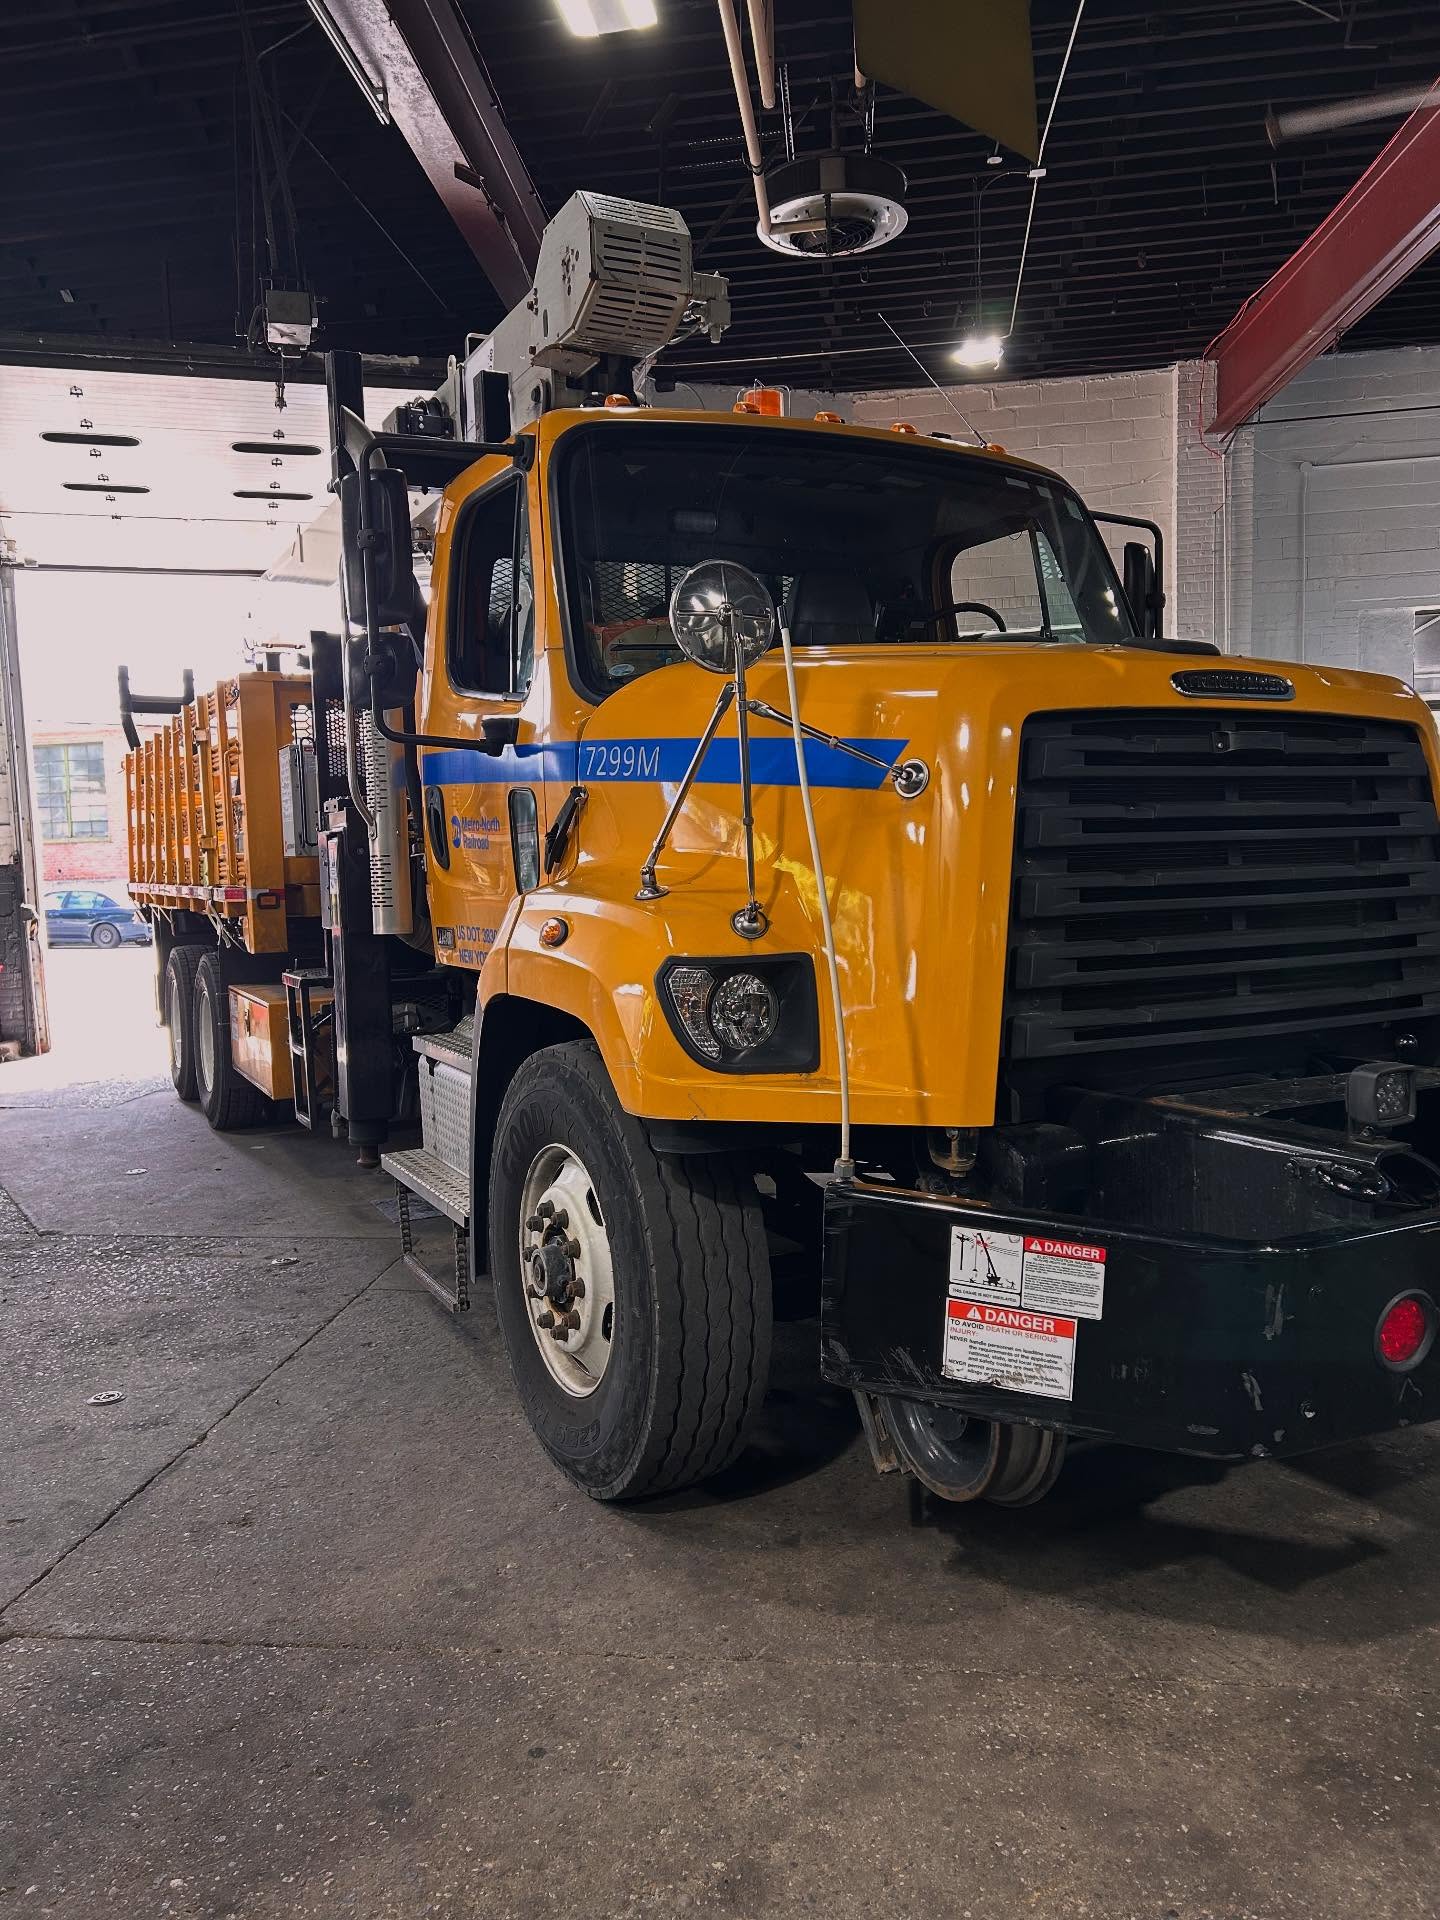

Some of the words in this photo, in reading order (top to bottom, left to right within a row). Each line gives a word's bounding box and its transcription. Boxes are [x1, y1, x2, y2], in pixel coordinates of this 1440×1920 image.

[586, 746, 660, 777] 7299M
[462, 816, 500, 832] Metro-North
[463, 834, 489, 850] Railroad
[456, 925, 466, 940] US
[467, 926, 480, 942] DOT
[459, 948, 473, 964] NEW
[1044, 1242, 1099, 1259] DANGER
[984, 1308, 1055, 1332] DANGER
[949, 1334, 967, 1342] NEVER
[950, 1318, 960, 1326] TO
[961, 1320, 984, 1330] AVOID
[985, 1324, 1010, 1335] DEATH
[1011, 1329, 1022, 1337] OR
[1025, 1332, 1057, 1343] SERIOUS
